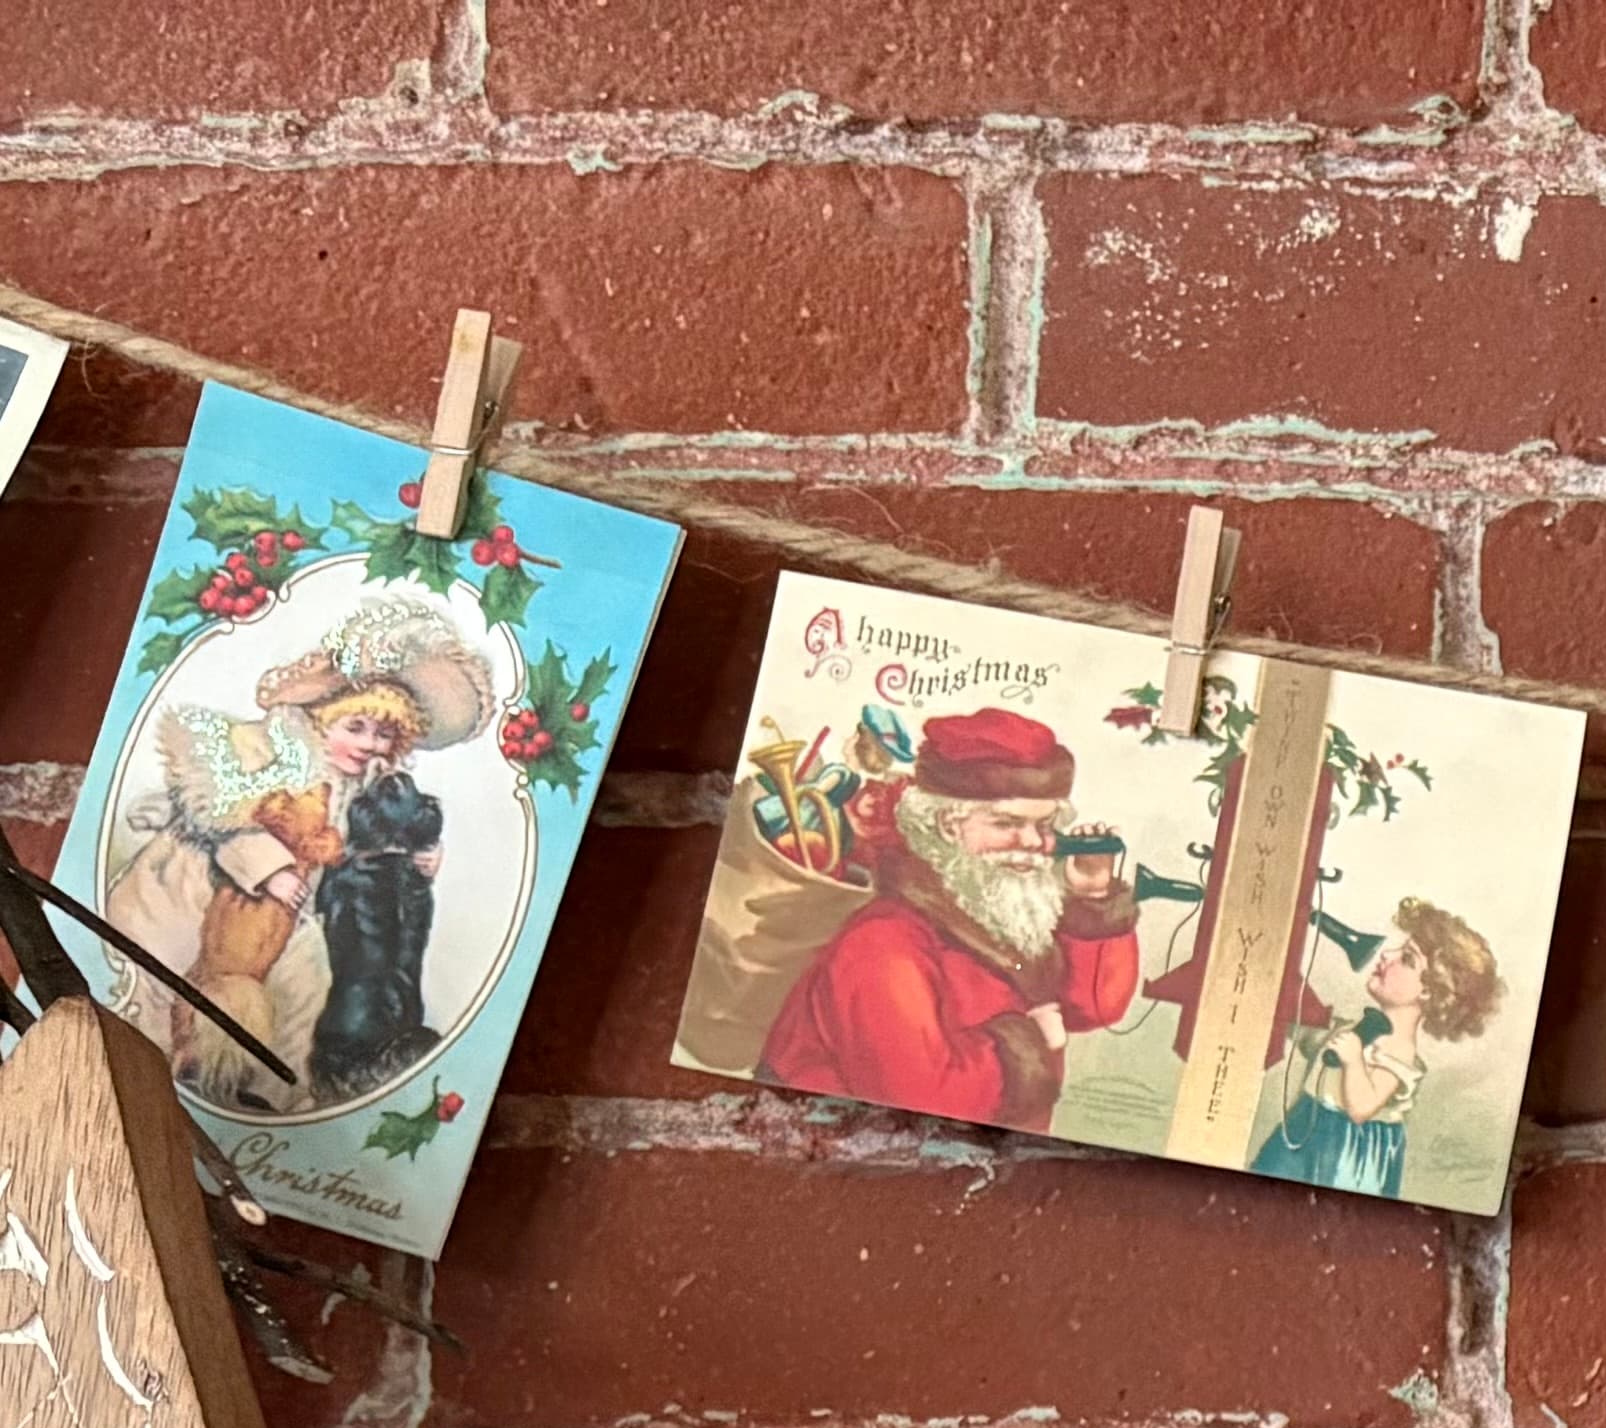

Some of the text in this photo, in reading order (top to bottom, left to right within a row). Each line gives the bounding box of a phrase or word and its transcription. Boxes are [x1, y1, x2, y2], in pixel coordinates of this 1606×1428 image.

[804, 606, 962, 682] A happy
[875, 656, 1061, 708] Christmas
[228, 1131, 403, 1220] Christmas
